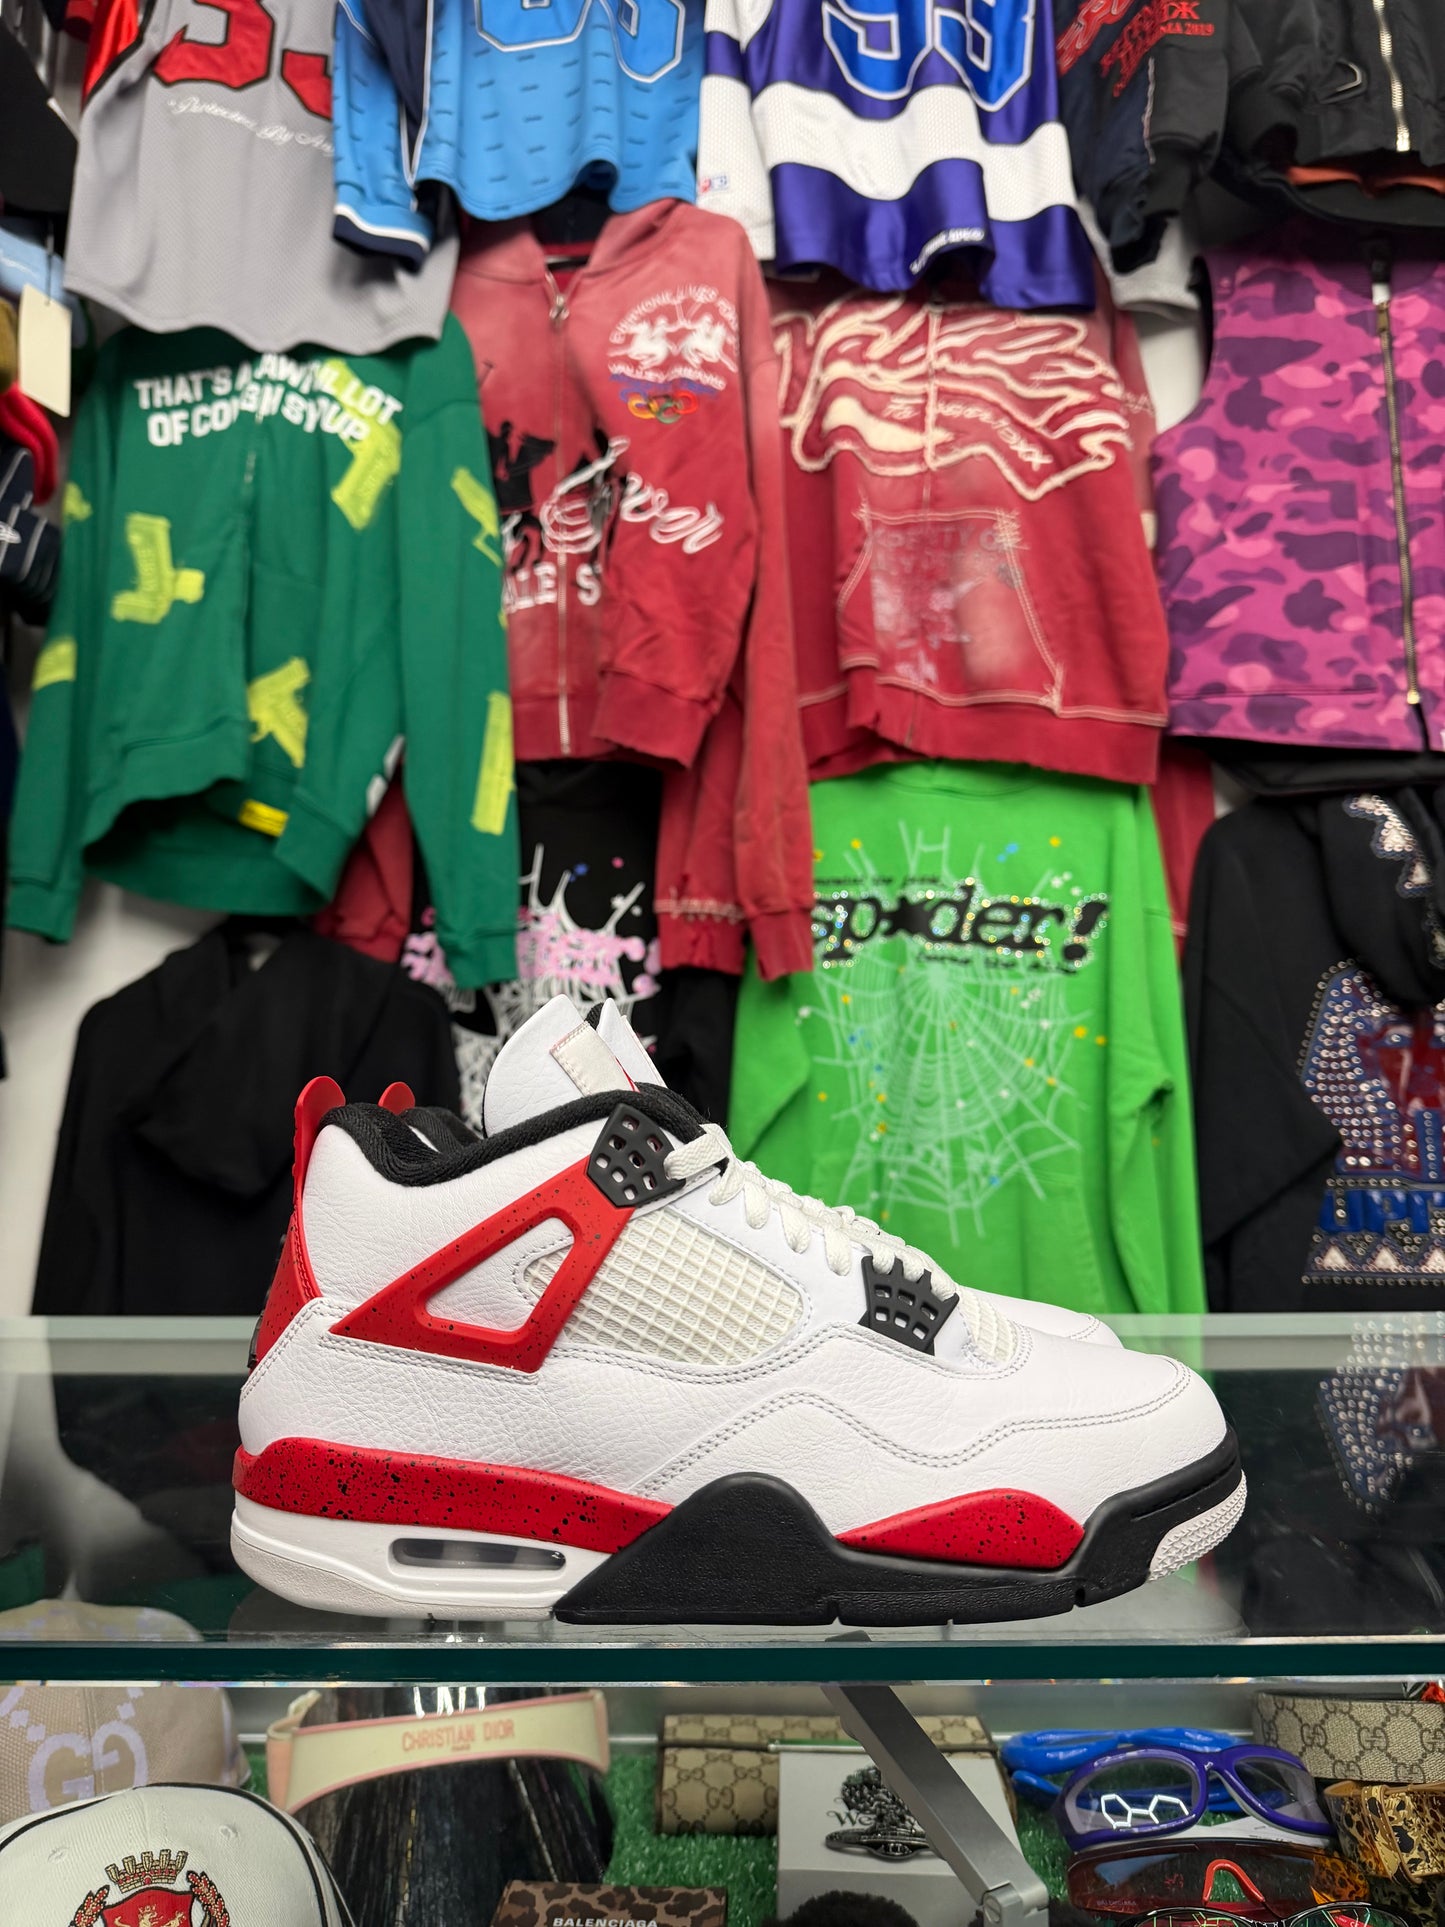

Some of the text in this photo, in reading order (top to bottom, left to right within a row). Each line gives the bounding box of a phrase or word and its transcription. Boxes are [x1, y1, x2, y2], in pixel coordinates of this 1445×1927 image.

[134, 366, 232, 410] THAT'S
[340, 377, 403, 426] LOT
[147, 409, 189, 447] OF
[401, 1719, 515, 1752] CHRISTIAN DIOR
[552, 1917, 658, 1927] BALENCIAGA
